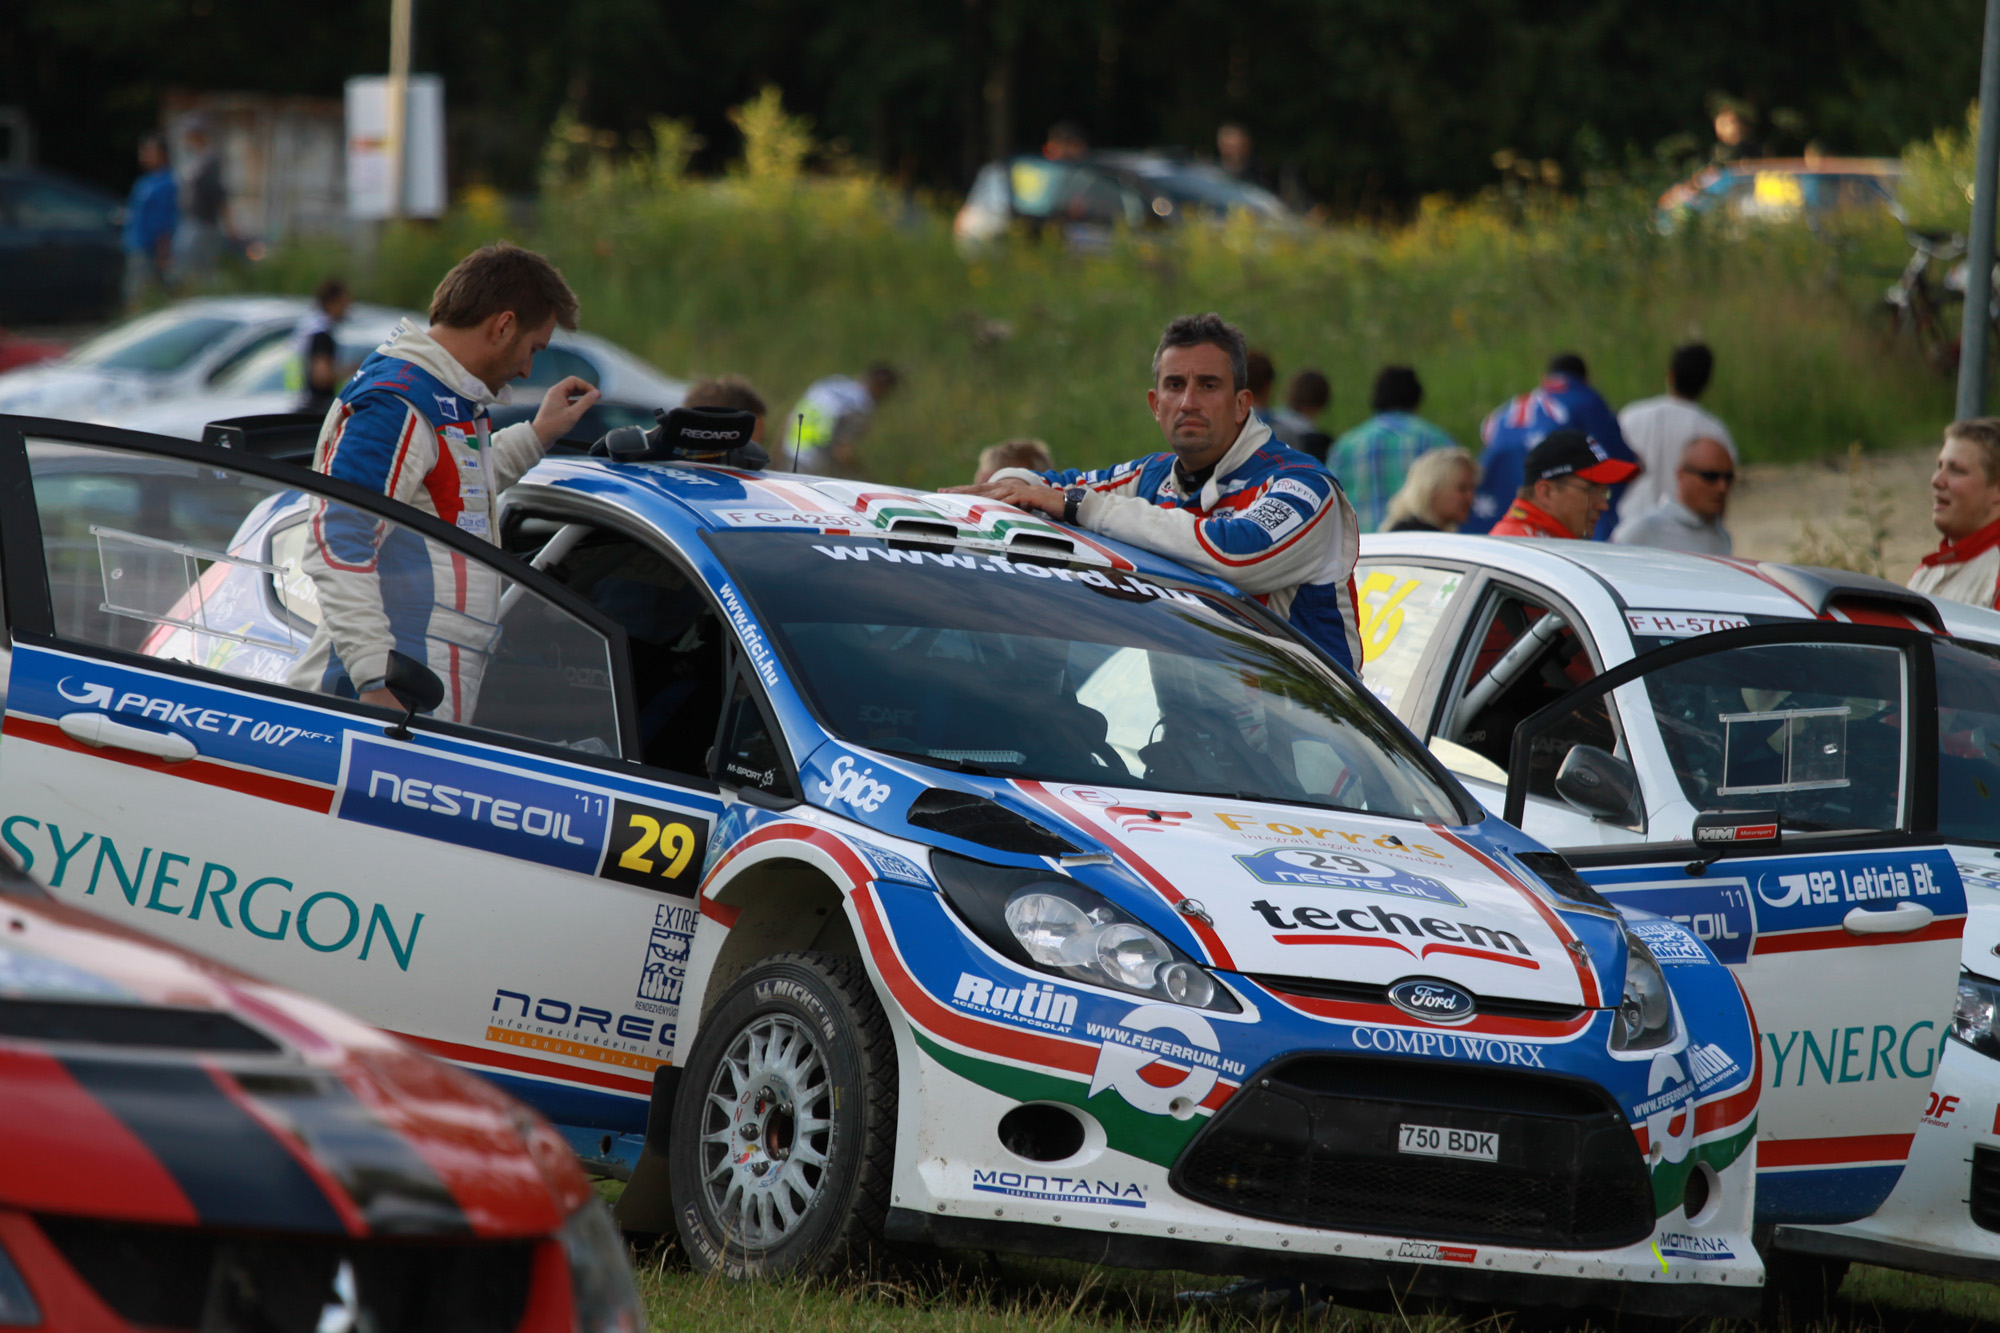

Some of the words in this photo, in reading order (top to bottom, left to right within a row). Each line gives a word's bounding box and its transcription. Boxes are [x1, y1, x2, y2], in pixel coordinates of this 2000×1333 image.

[679, 427, 741, 440] RECARO
[727, 512, 747, 523] F
[753, 511, 862, 528] G-4256
[811, 543, 1208, 608] www.ford.hu
[719, 582, 779, 688] www.frici.hu
[114, 692, 253, 737] PAKET
[250, 721, 300, 747] 007
[818, 755, 891, 813] Spice
[618, 813, 696, 880] 29
[1697, 827, 1735, 841] MM
[1294, 851, 1371, 874] 29
[0, 814, 426, 972] SYNERGON
[1275, 871, 1389, 893] NESTE
[1390, 883, 1441, 900] OIL
[1808, 870, 1838, 906] 92
[1840, 866, 1910, 902] Leticia
[1910, 861, 1941, 896] Bt.
[1249, 899, 1533, 957] techem
[953, 971, 1079, 1026] Rutin
[1410, 985, 1457, 1010] Ford
[1003, 1012, 1072, 1034] KAPCSOLAT
[1085, 1021, 1246, 1077] WWW.FEFERRUM.HU
[1351, 1026, 1547, 1069] COMPUWORX
[1403, 1126, 1441, 1150] 750
[1447, 1131, 1495, 1156] BDK
[973, 1169, 1144, 1199] MONTANA
[1397, 1241, 1439, 1260] MM
[1660, 1232, 1730, 1252] MONTANA
